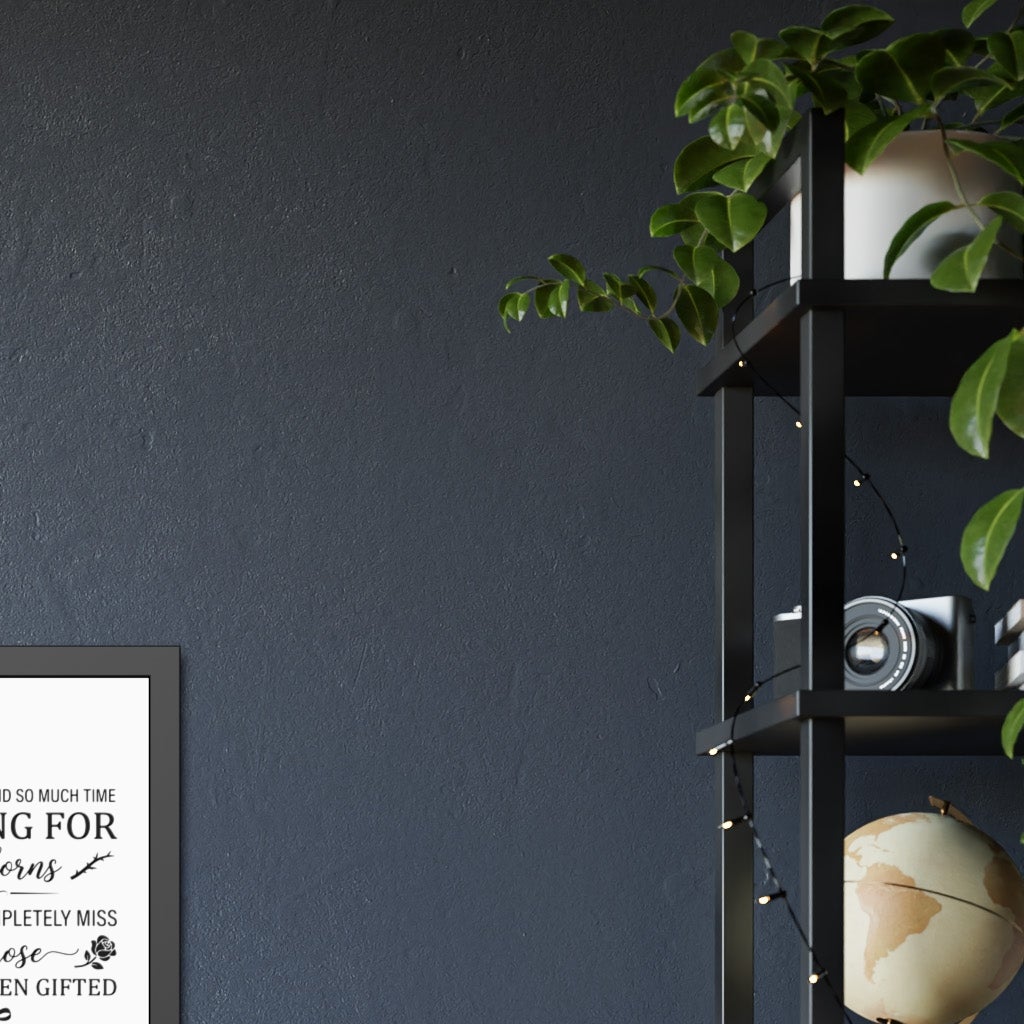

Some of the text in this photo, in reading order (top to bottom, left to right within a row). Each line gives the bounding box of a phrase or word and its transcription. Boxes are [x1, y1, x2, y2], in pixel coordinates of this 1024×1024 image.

[15, 788, 34, 803] SO
[38, 788, 79, 803] MUCH
[83, 788, 116, 803] TIME
[45, 811, 118, 840] FOR
[76, 909, 118, 927] MISS
[35, 978, 118, 997] GIFTED
